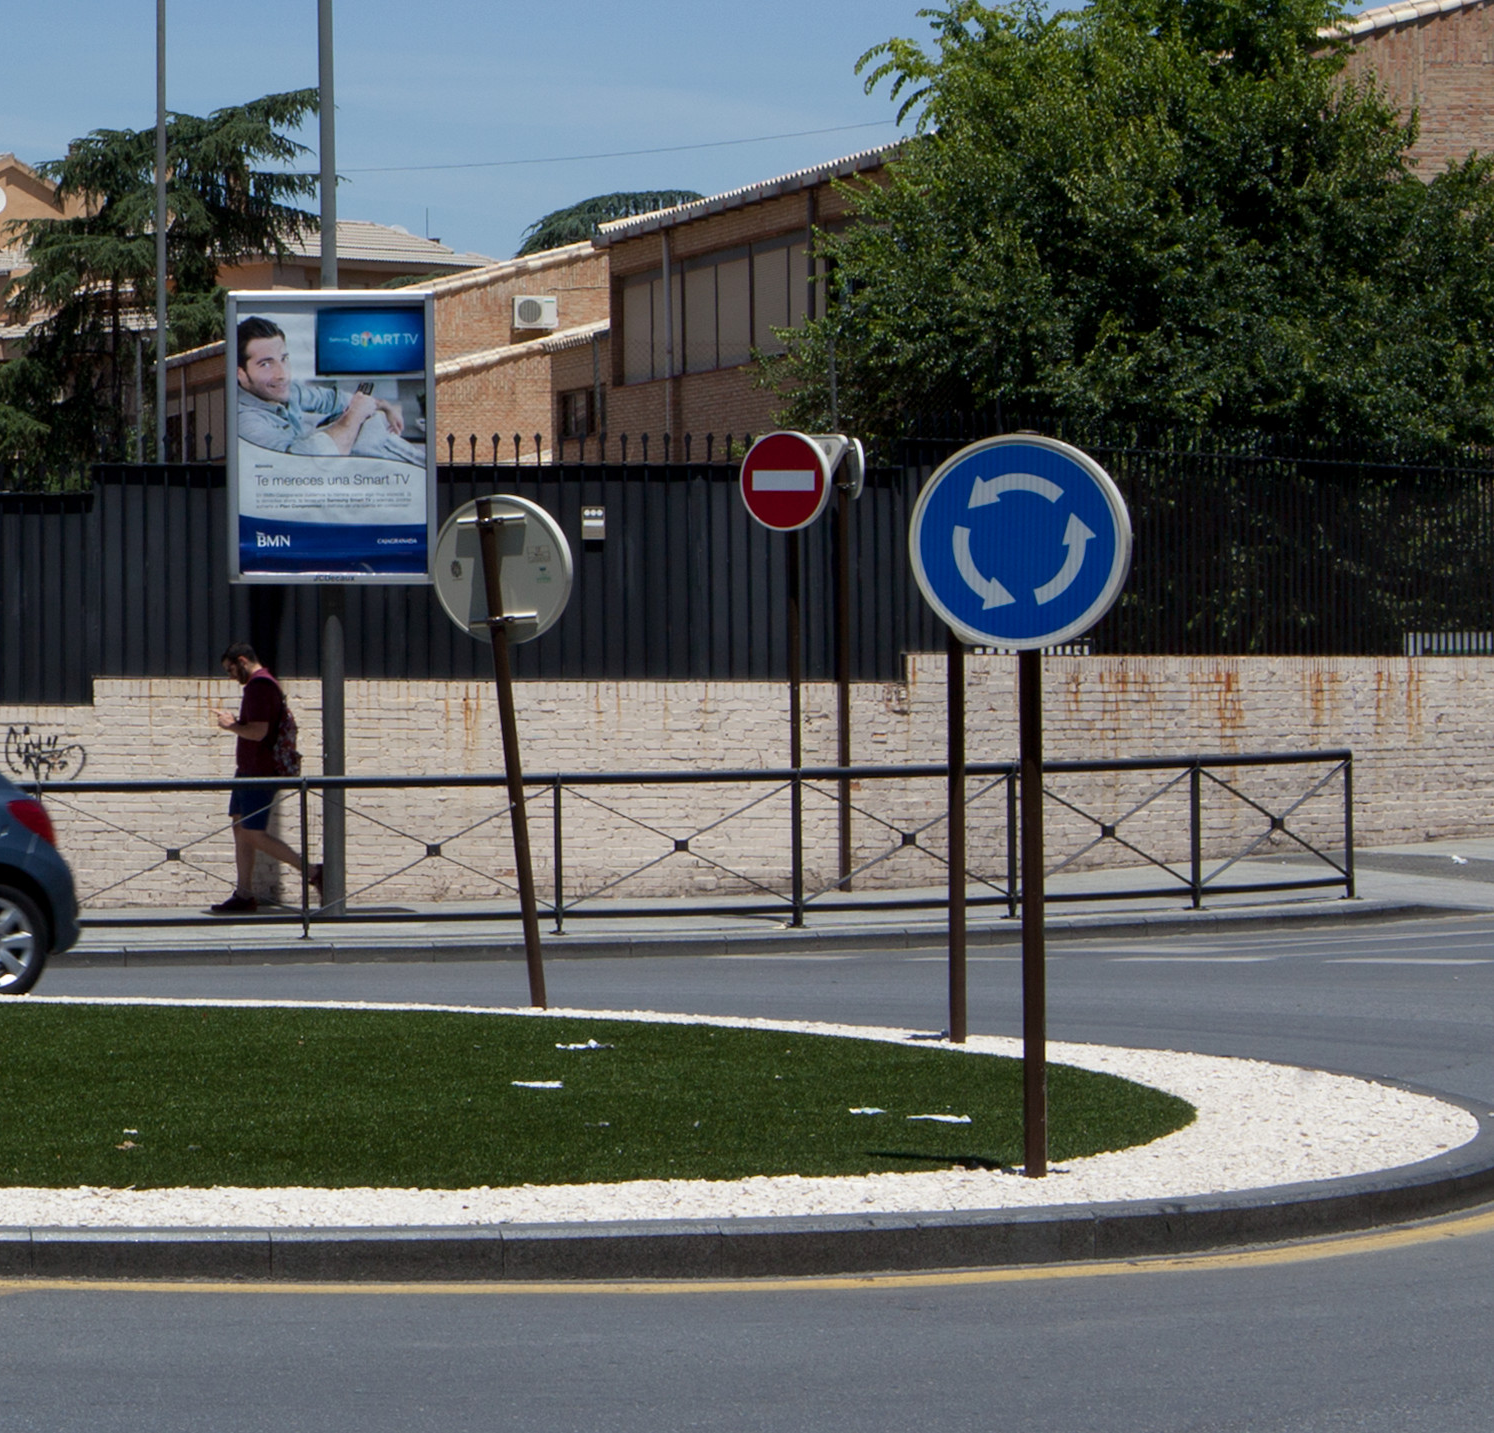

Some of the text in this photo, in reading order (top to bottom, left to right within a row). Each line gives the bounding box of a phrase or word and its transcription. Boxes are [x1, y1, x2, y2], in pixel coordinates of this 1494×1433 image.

[402, 332, 419, 345] TV
[255, 473, 410, 486] Te mereces una Smart TV
[256, 534, 291, 548] BMN
[313, 574, 355, 582] JCDecaux
